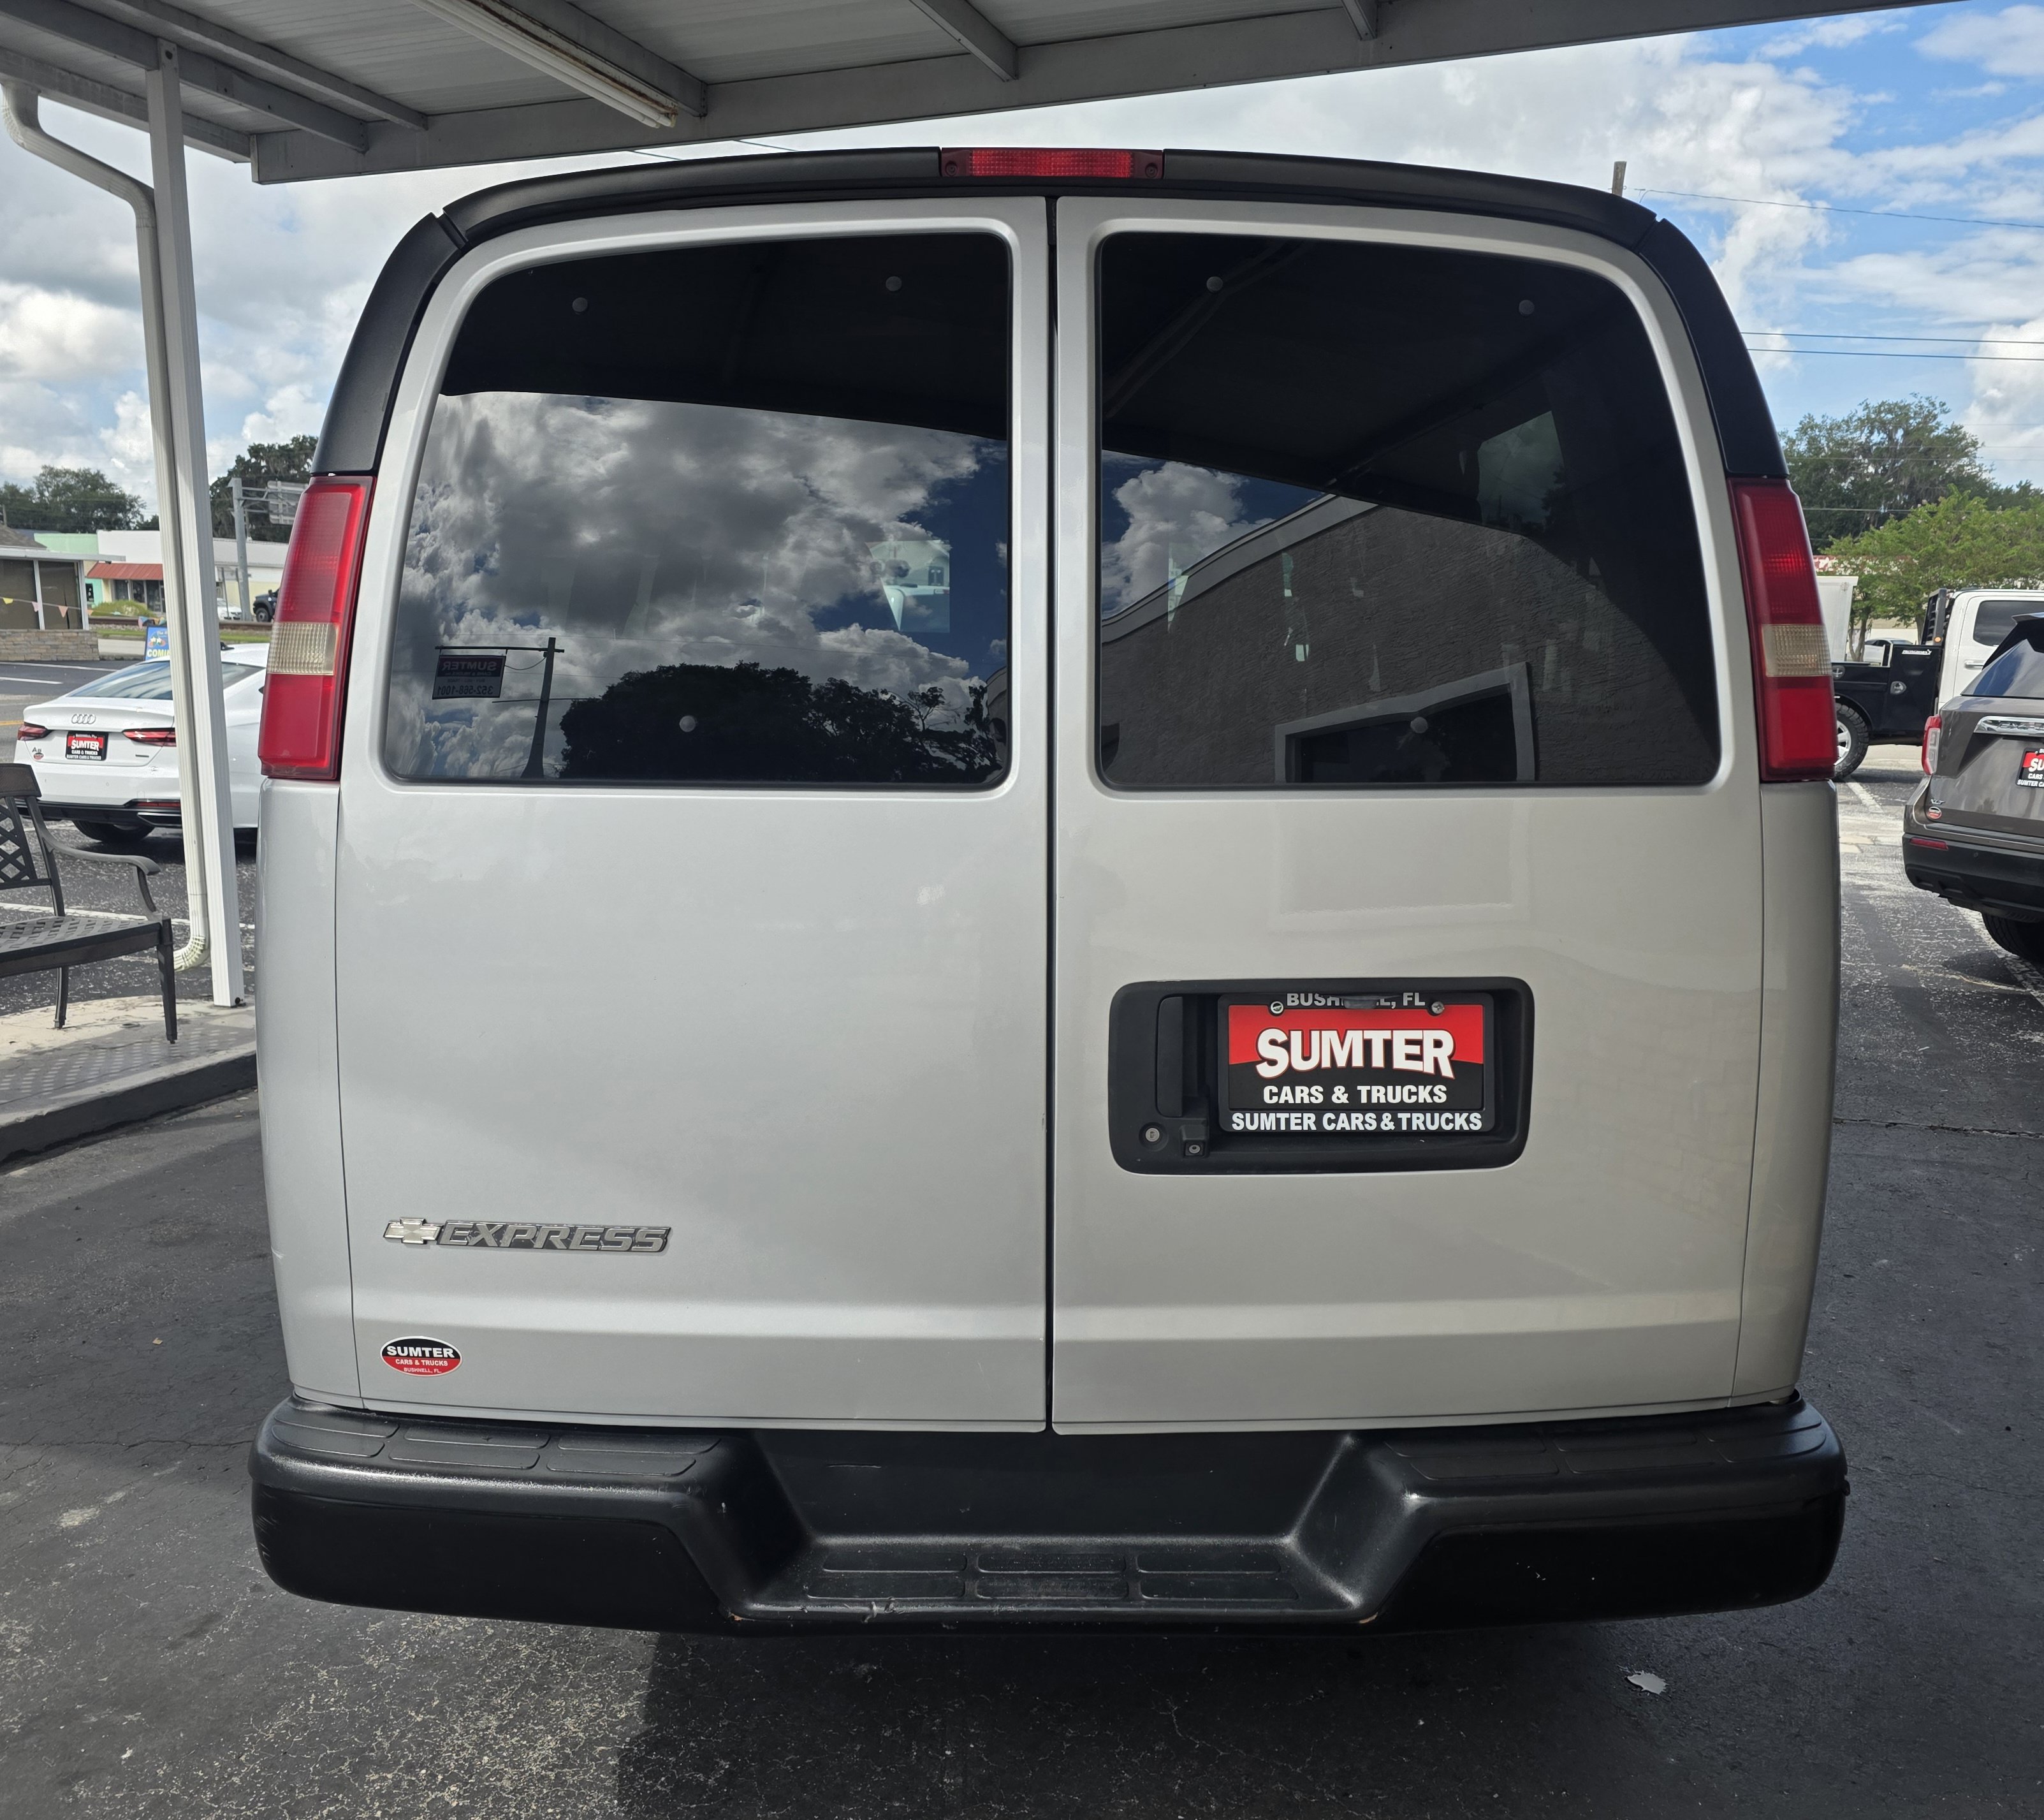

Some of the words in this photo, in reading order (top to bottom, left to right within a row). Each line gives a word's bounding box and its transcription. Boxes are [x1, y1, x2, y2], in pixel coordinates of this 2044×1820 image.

[71, 740, 99, 751] SUMTER
[1403, 992, 1426, 1006] FL
[1255, 1027, 1456, 1080] SUMTER
[1263, 1085, 1324, 1104] CARS
[1331, 1085, 1349, 1104] &
[1357, 1085, 1447, 1104] TRUCKS
[1232, 1112, 1317, 1131] SUMTER
[437, 1221, 668, 1252] EXPRESS
[386, 1346, 455, 1358] SUMTER
